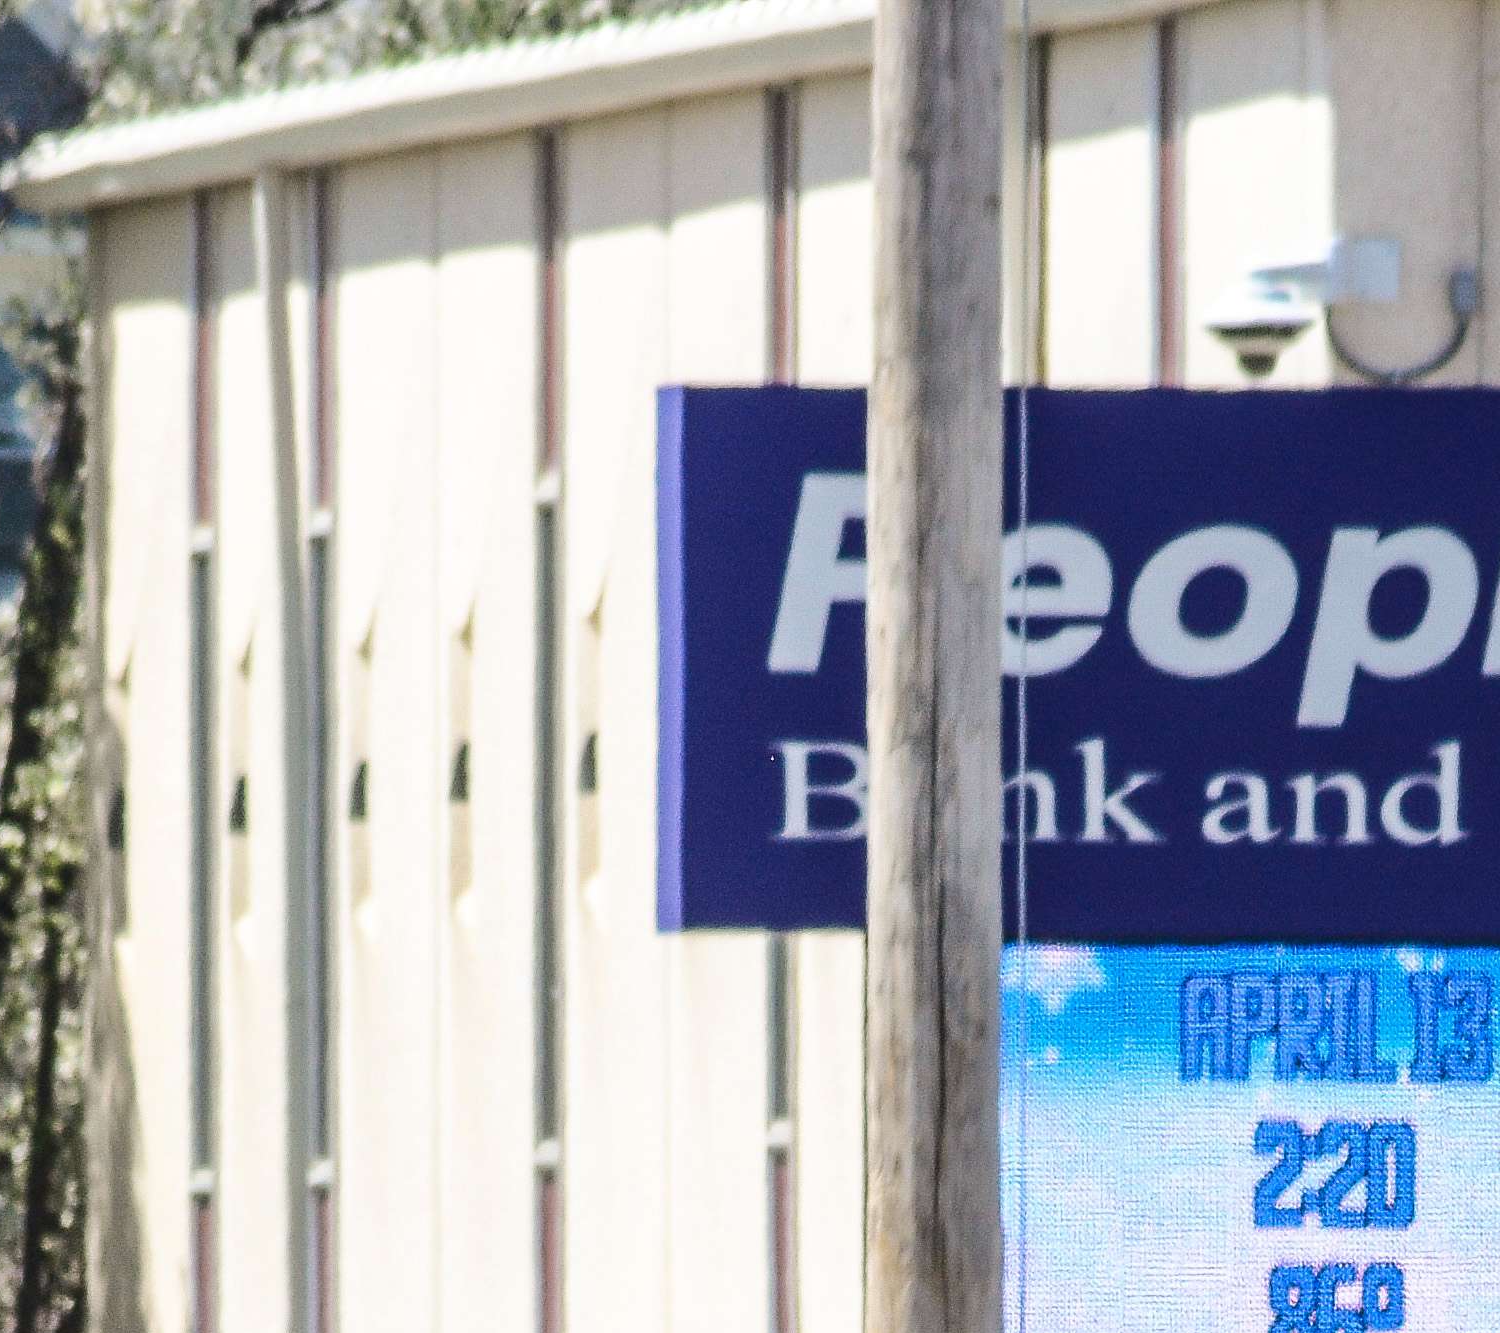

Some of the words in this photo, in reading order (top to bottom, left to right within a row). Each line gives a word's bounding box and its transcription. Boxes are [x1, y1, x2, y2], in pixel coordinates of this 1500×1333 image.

[772, 737, 1168, 845] Bnk
[1200, 739, 1470, 847] and
[1181, 970, 1398, 1083] APRIL
[1408, 970, 1496, 1083] 13
